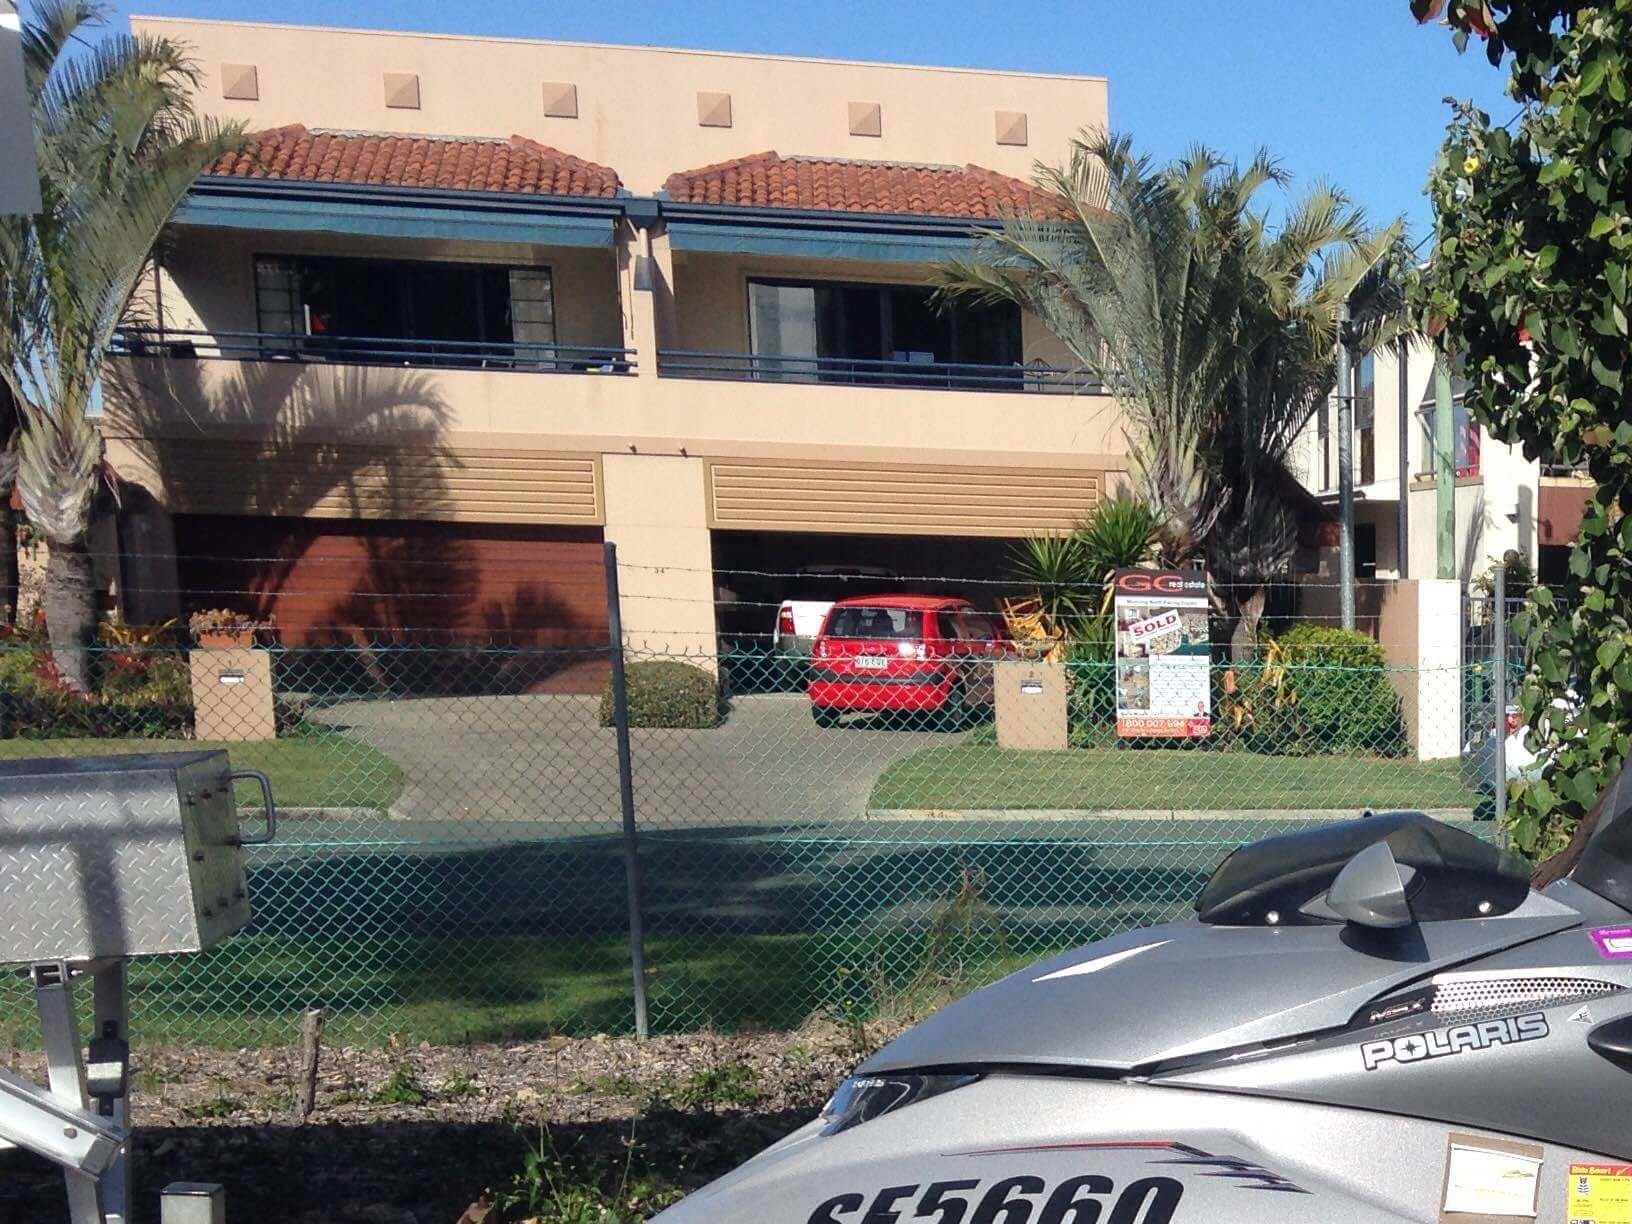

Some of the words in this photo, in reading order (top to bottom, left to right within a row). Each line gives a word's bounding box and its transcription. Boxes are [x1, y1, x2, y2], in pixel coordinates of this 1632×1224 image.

[1119, 574, 1183, 592] GC
[1134, 615, 1177, 636] SOLD
[1361, 1012, 1549, 1070] POLARIS
